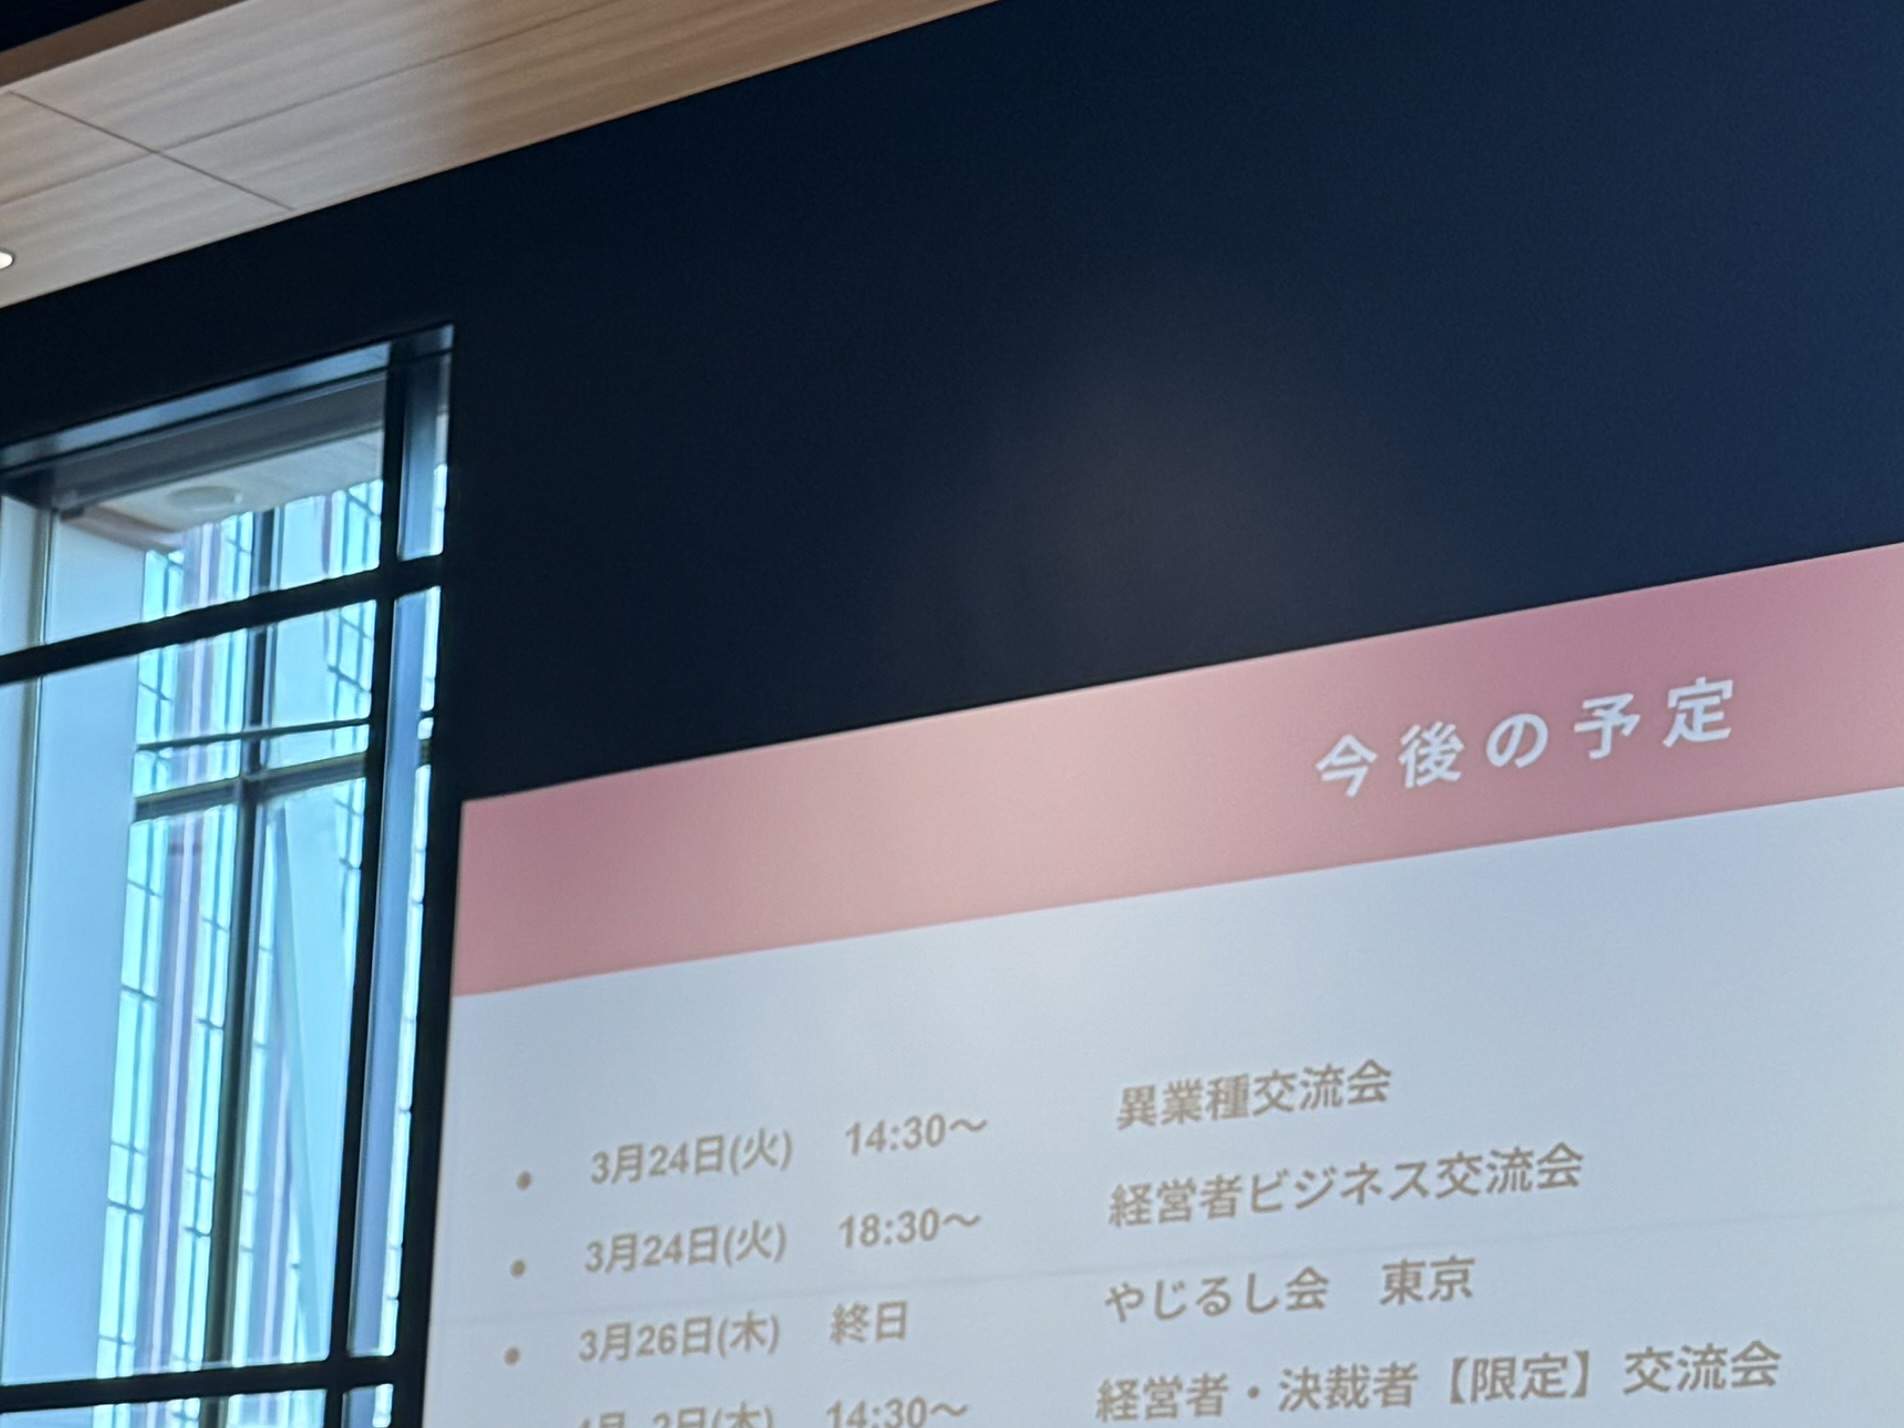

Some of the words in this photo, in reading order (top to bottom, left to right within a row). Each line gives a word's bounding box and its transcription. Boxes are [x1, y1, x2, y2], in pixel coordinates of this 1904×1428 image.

[1314, 677, 1734, 797] 今後の予定
[590, 1127, 793, 1185] 3月24日(火)
[1118, 1060, 1392, 1128] 異業種交流会
[585, 1219, 786, 1272] 3月24日(火)
[1109, 1142, 1584, 1227] 経営者ビジネス交流会
[579, 1310, 779, 1362] 3月26日(木)
[832, 1300, 908, 1344] 終日
[1105, 1266, 1328, 1323] やじるし会
[1381, 1254, 1477, 1306] 東京
